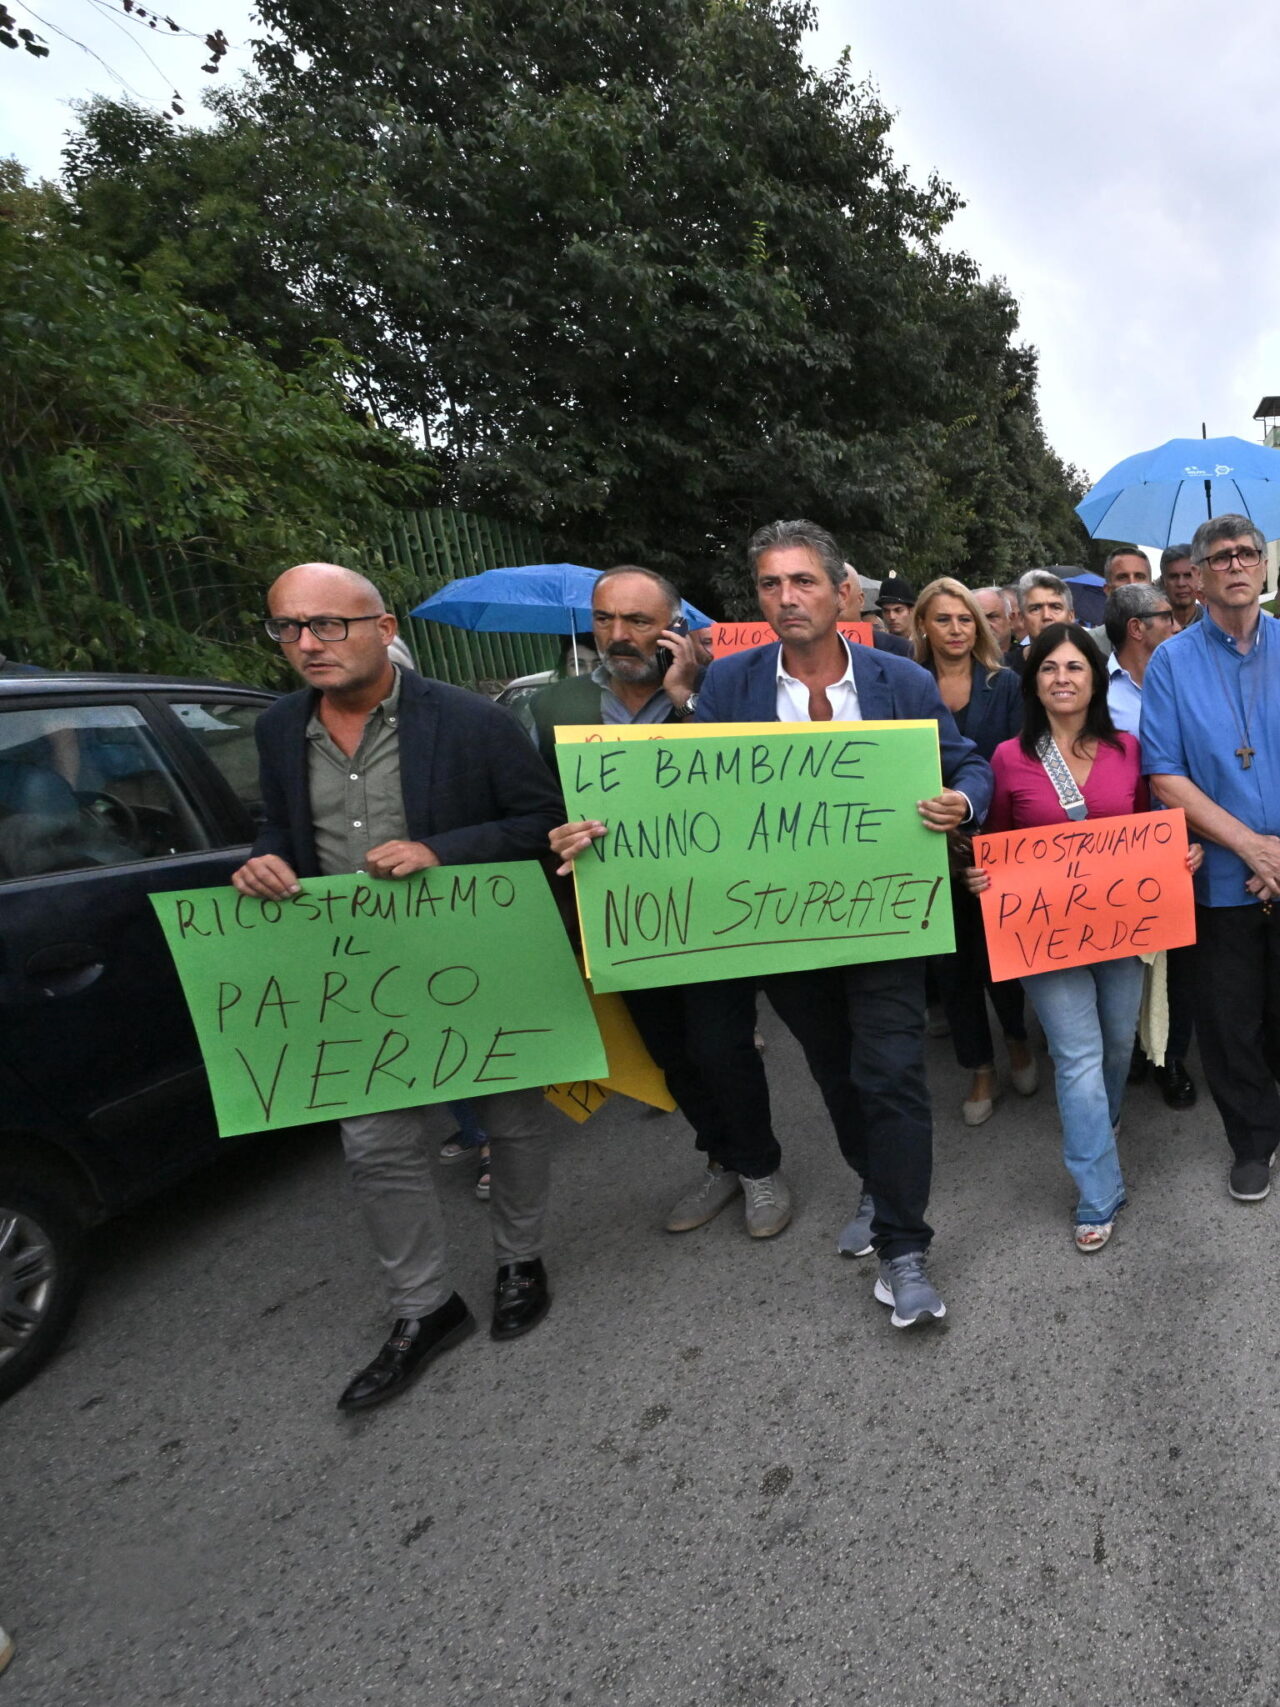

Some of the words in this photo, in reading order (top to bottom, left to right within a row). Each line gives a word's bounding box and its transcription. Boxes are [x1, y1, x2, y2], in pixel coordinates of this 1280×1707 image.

[576, 750, 627, 793] LE
[656, 739, 880, 788] BAMBINE
[581, 809, 721, 862] VANNO
[748, 801, 896, 853] AMATE
[979, 822, 1172, 868] RICOSTRUIAMO
[1067, 861, 1091, 878] IL
[177, 875, 515, 939] RICOSTRUIAMO
[605, 877, 694, 948] NON
[713, 873, 944, 935] STUPRATE!
[999, 877, 1161, 929] PARCO
[333, 935, 370, 957] IL
[1014, 916, 1159, 968] VERDE
[218, 965, 480, 1032] PARCO
[235, 1027, 553, 1122] VERDE
